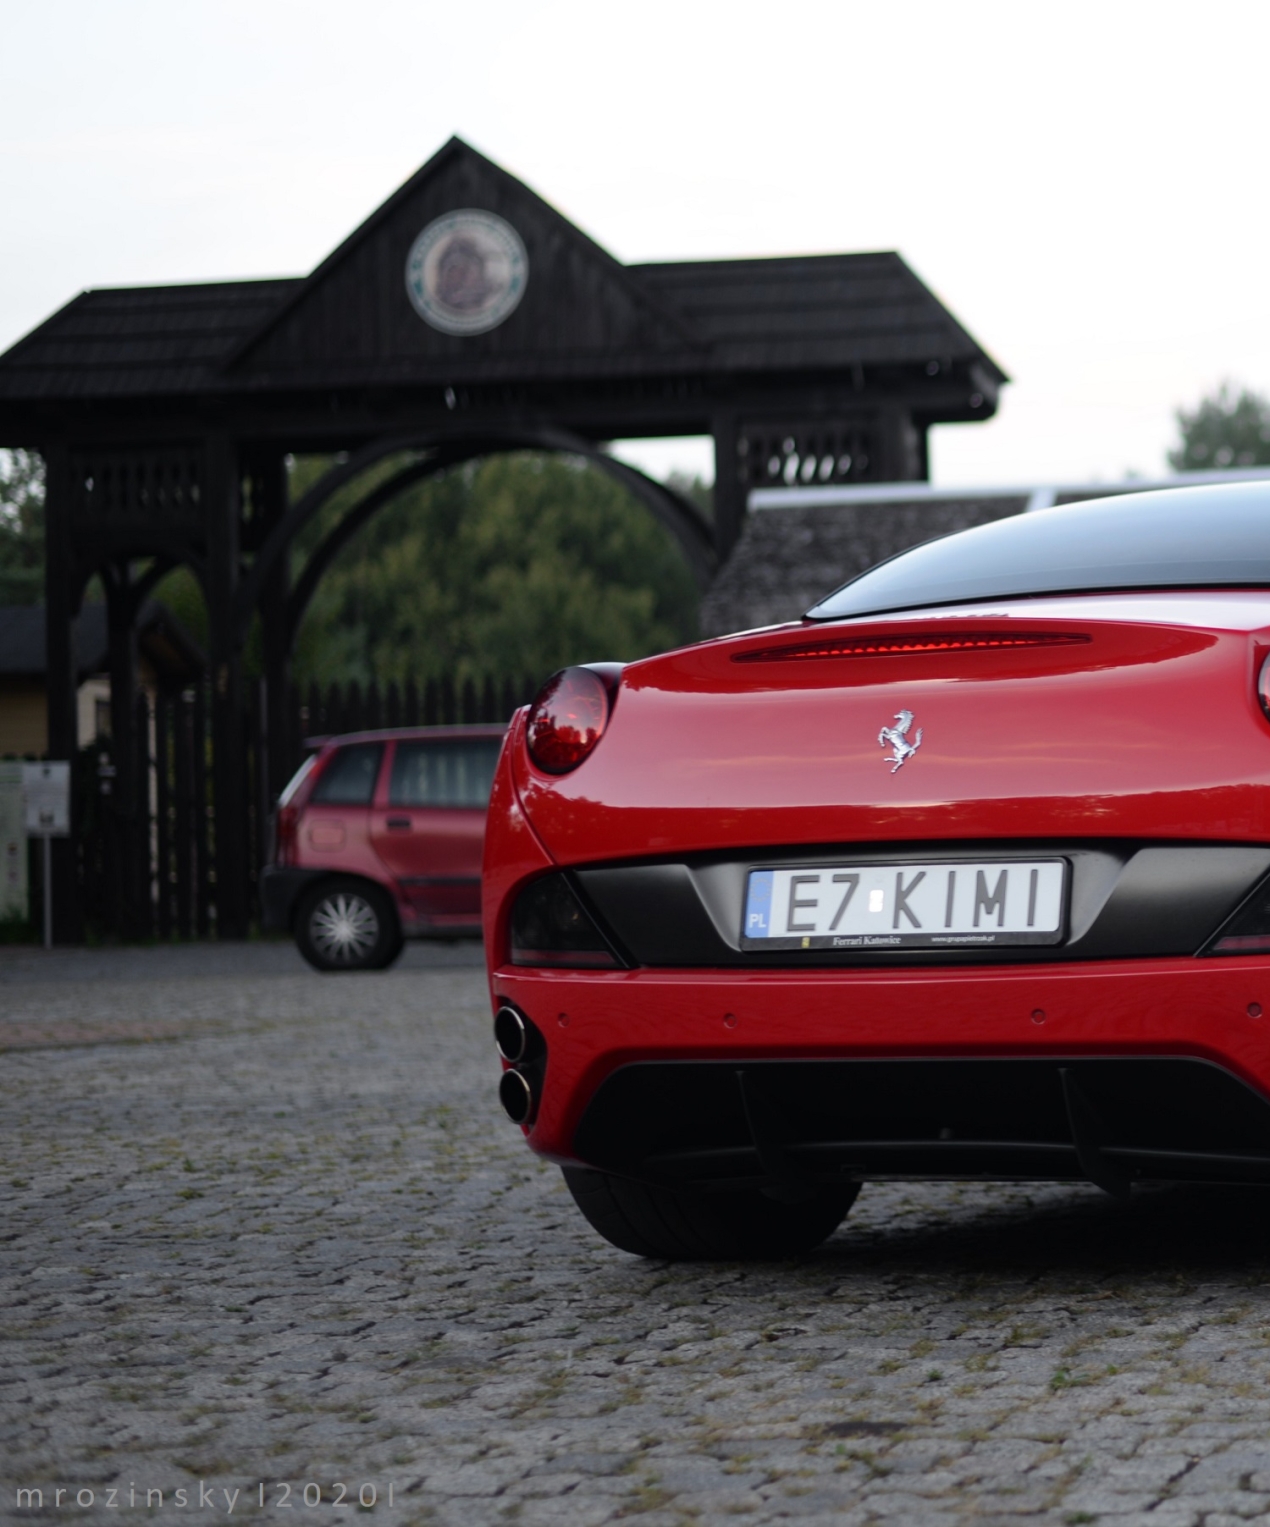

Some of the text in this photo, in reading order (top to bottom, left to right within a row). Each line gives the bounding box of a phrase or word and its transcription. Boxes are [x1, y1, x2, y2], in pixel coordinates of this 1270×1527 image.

[786, 869, 1038, 932] E7 KIMI
[749, 913, 767, 929] PL
[832, 935, 901, 946] Ferrari Katowice
